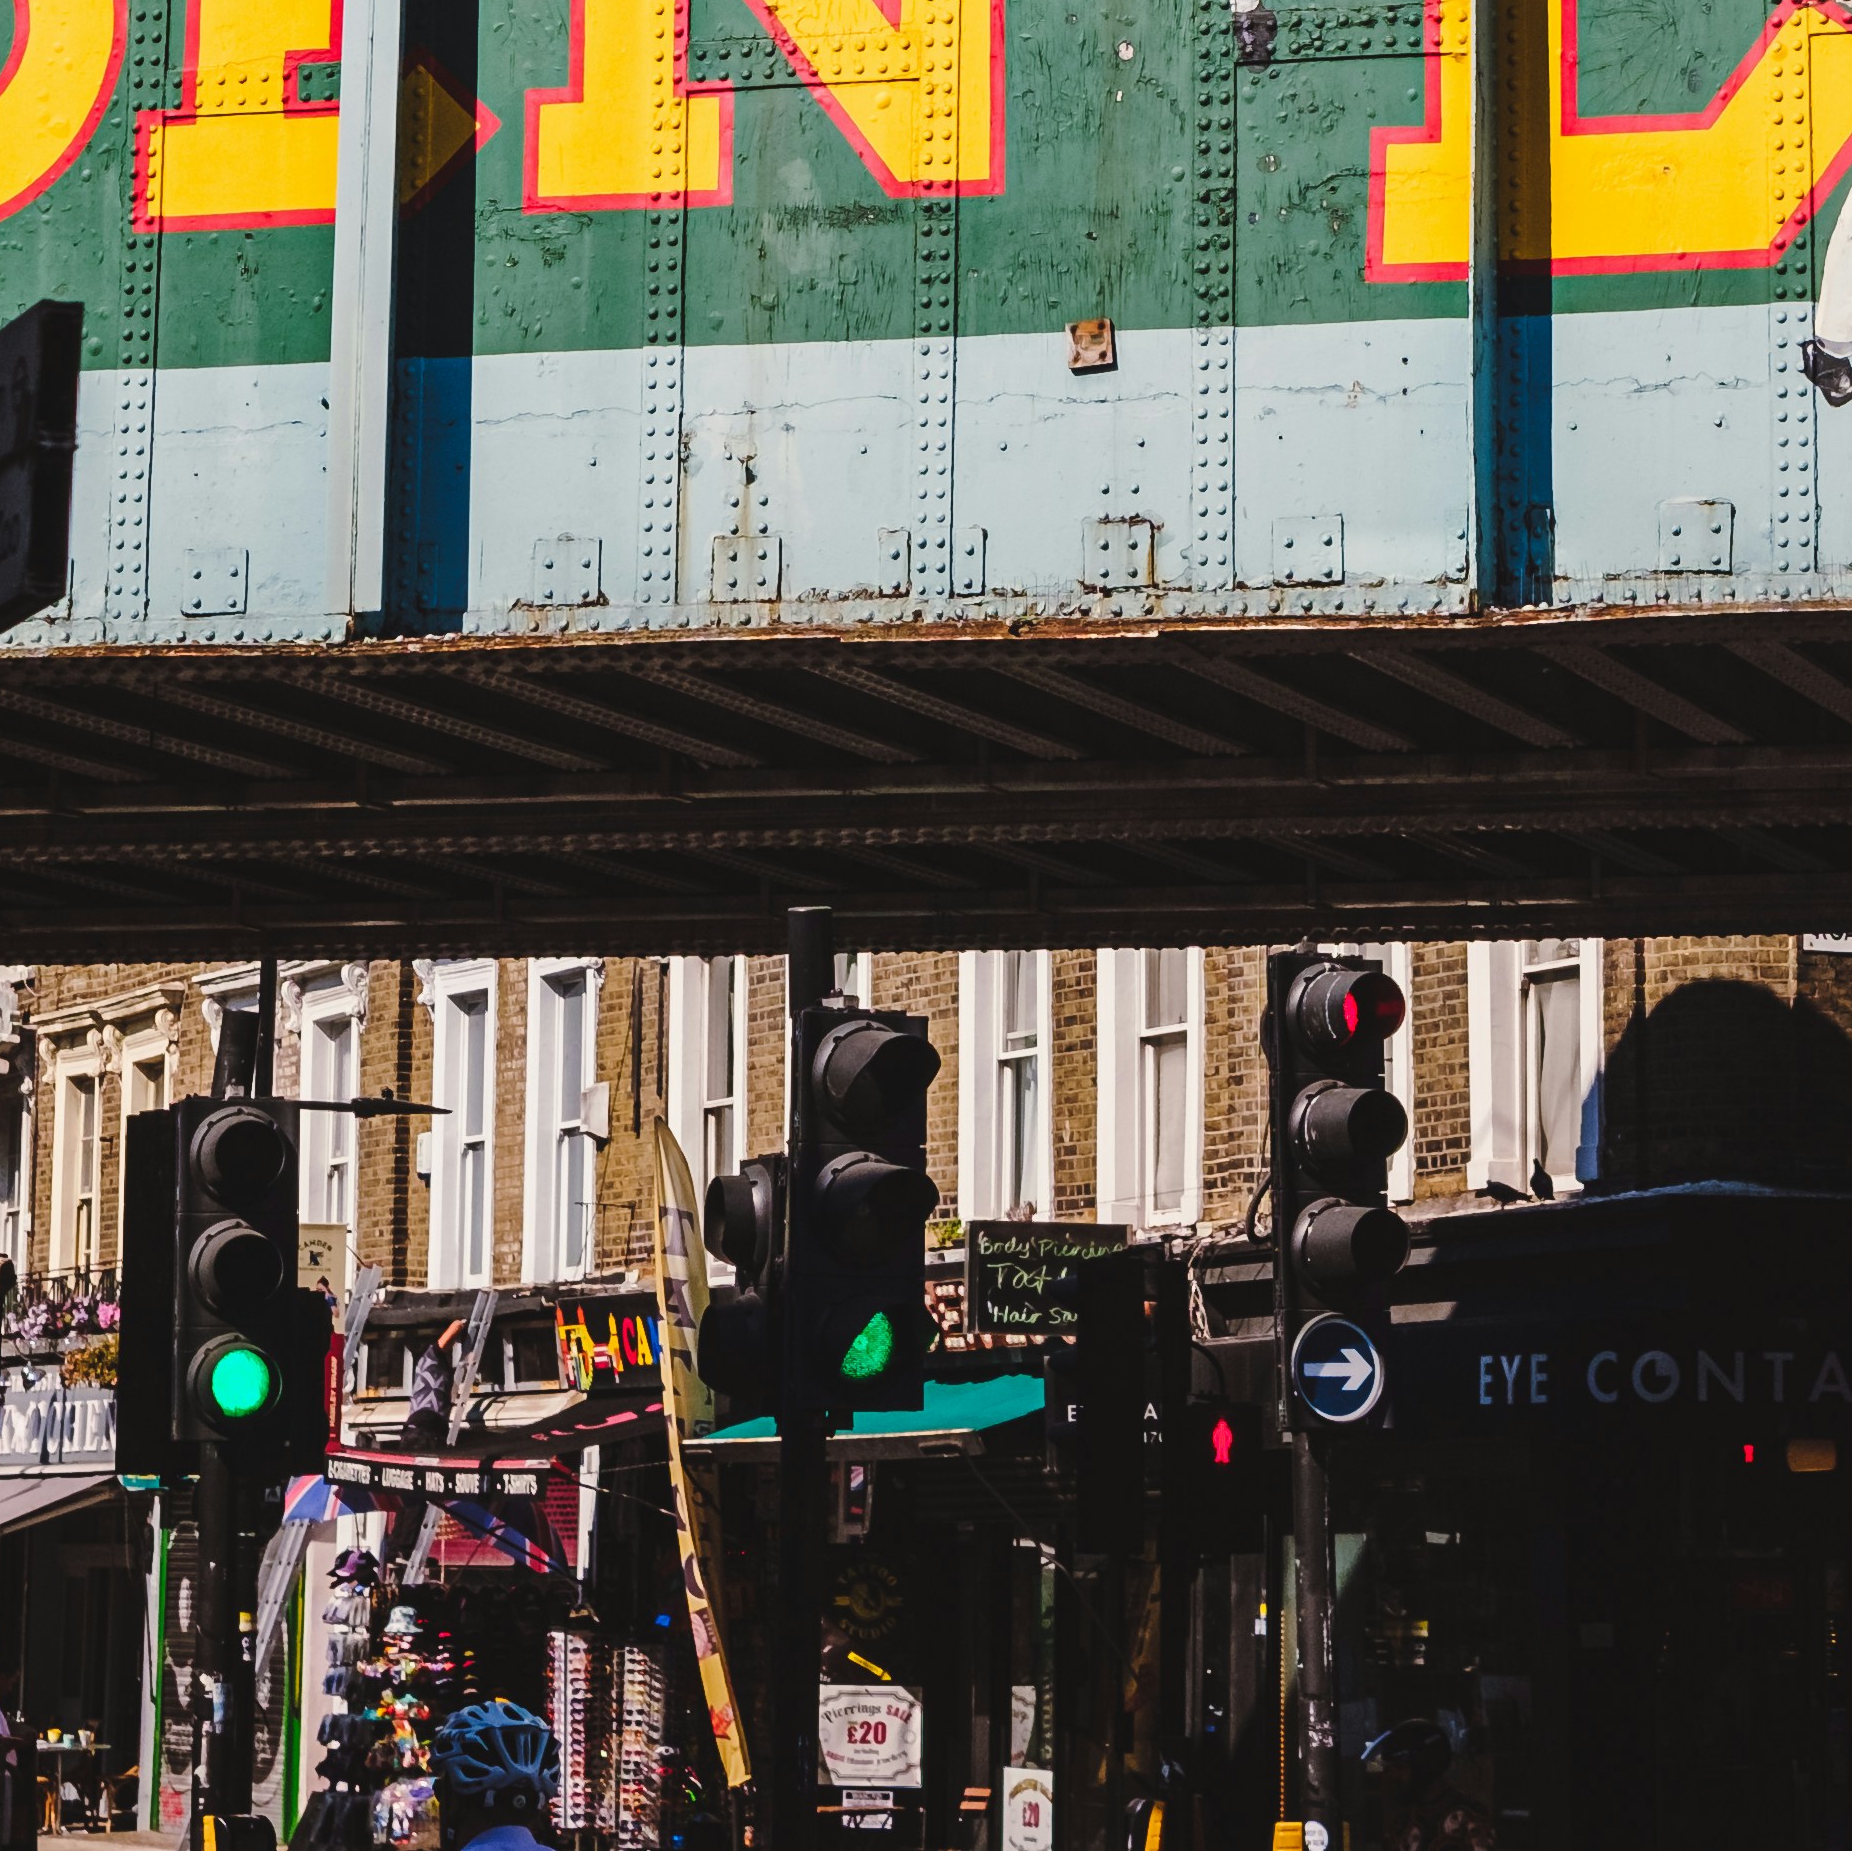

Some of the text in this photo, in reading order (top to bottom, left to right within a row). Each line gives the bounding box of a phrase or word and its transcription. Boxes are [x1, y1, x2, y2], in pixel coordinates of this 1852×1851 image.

[978, 1236, 1031, 1259] Body
[1479, 1353, 1549, 1406] EYE
[425, 1471, 445, 1493] HATS
[836, 1561, 899, 1587] TATTOO
[838, 1616, 898, 1640] STUDIO
[885, 1704, 913, 1724] SALE
[846, 1720, 887, 1745] £20
